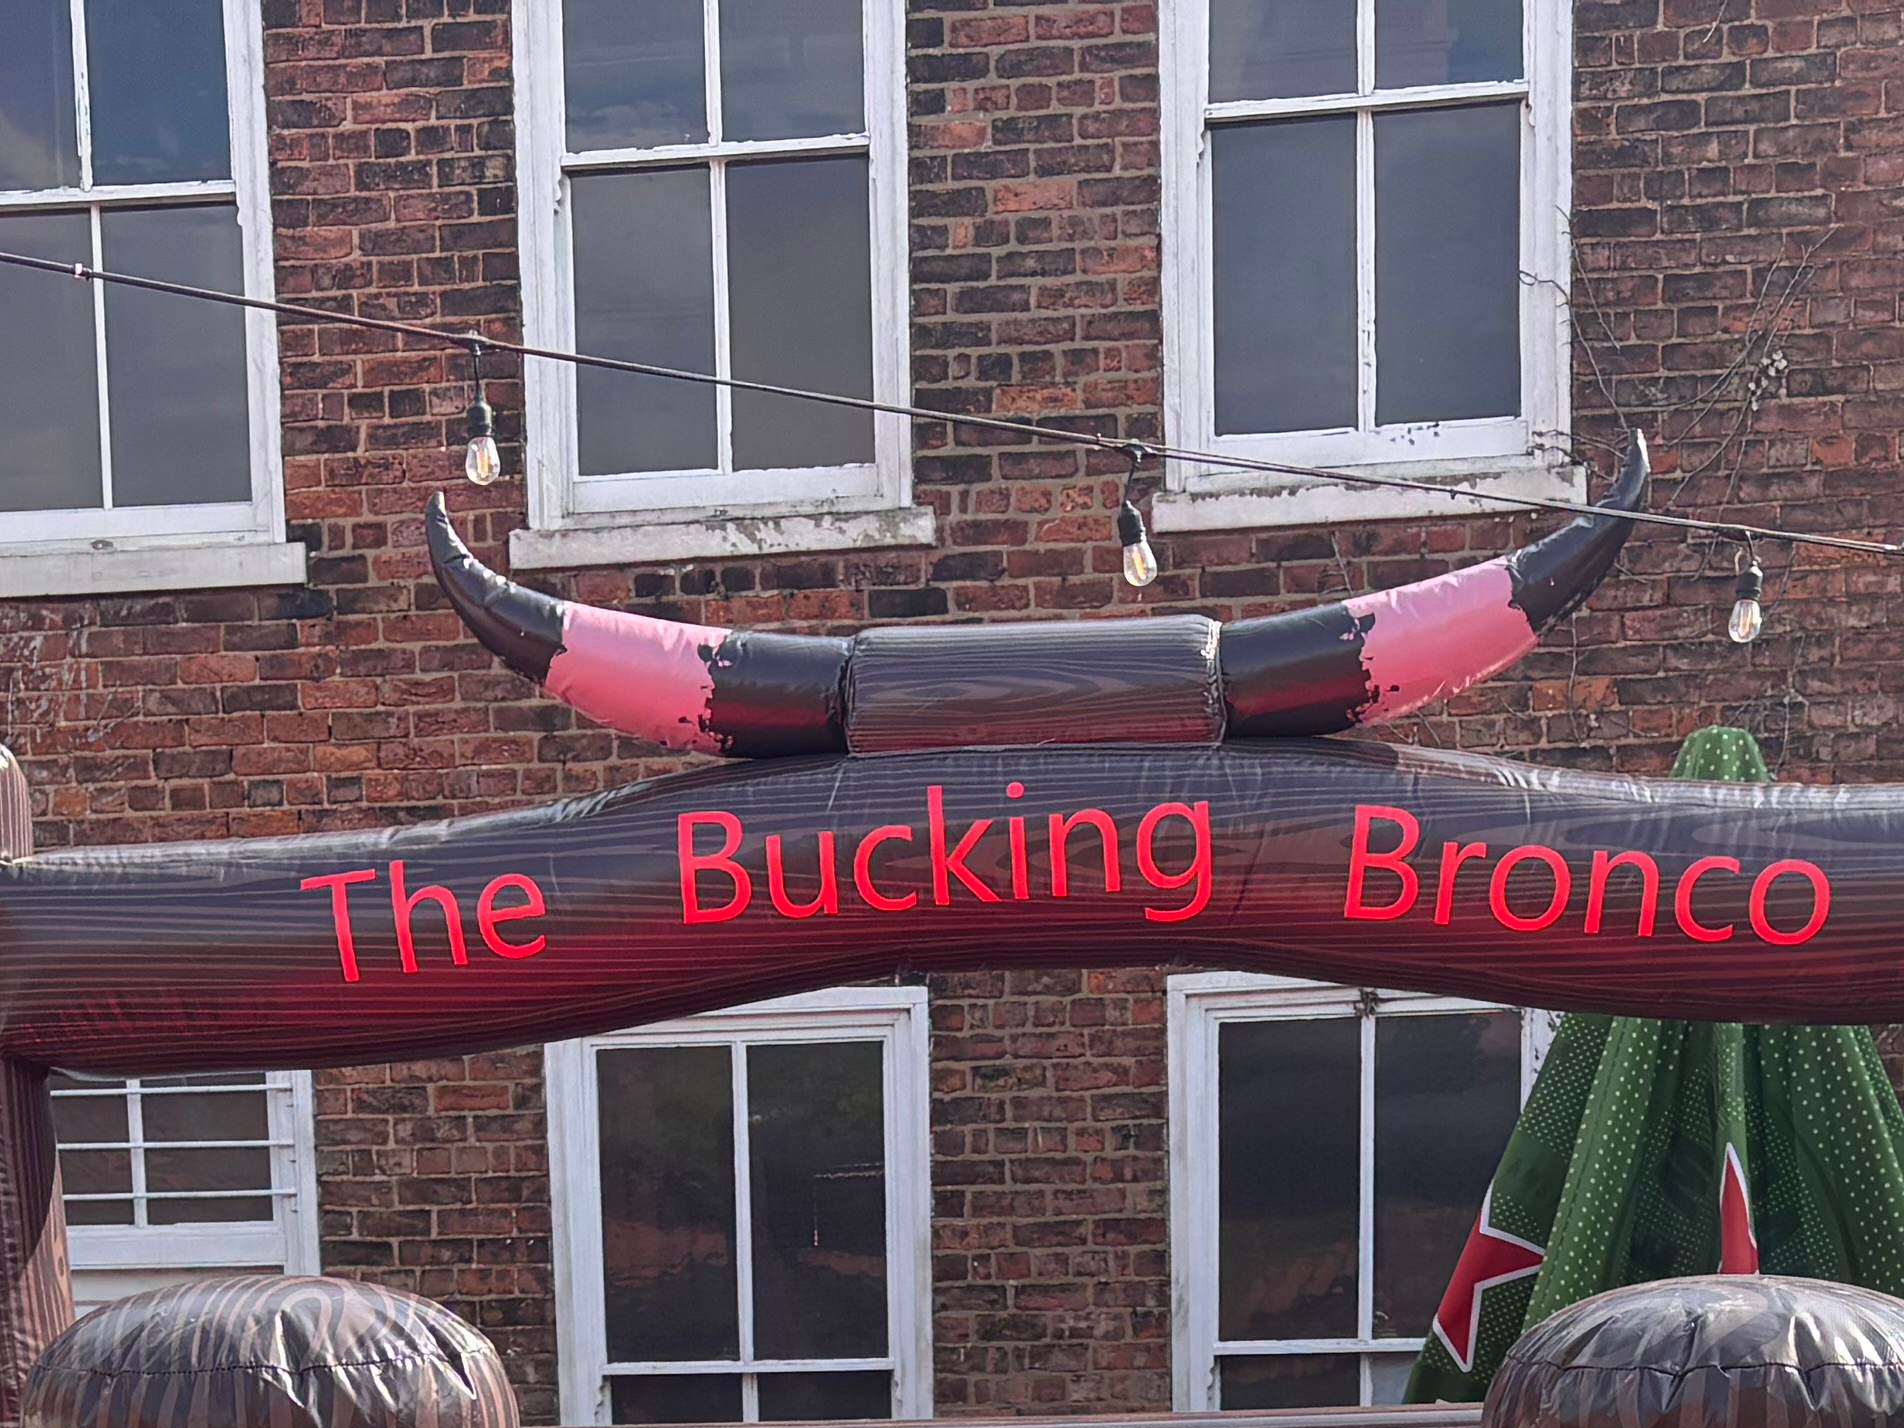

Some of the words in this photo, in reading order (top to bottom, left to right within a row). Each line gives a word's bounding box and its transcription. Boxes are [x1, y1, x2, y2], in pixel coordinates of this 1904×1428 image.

[298, 867, 547, 983] The
[676, 781, 1211, 922] Bucking
[1342, 803, 1832, 945] Bronco
